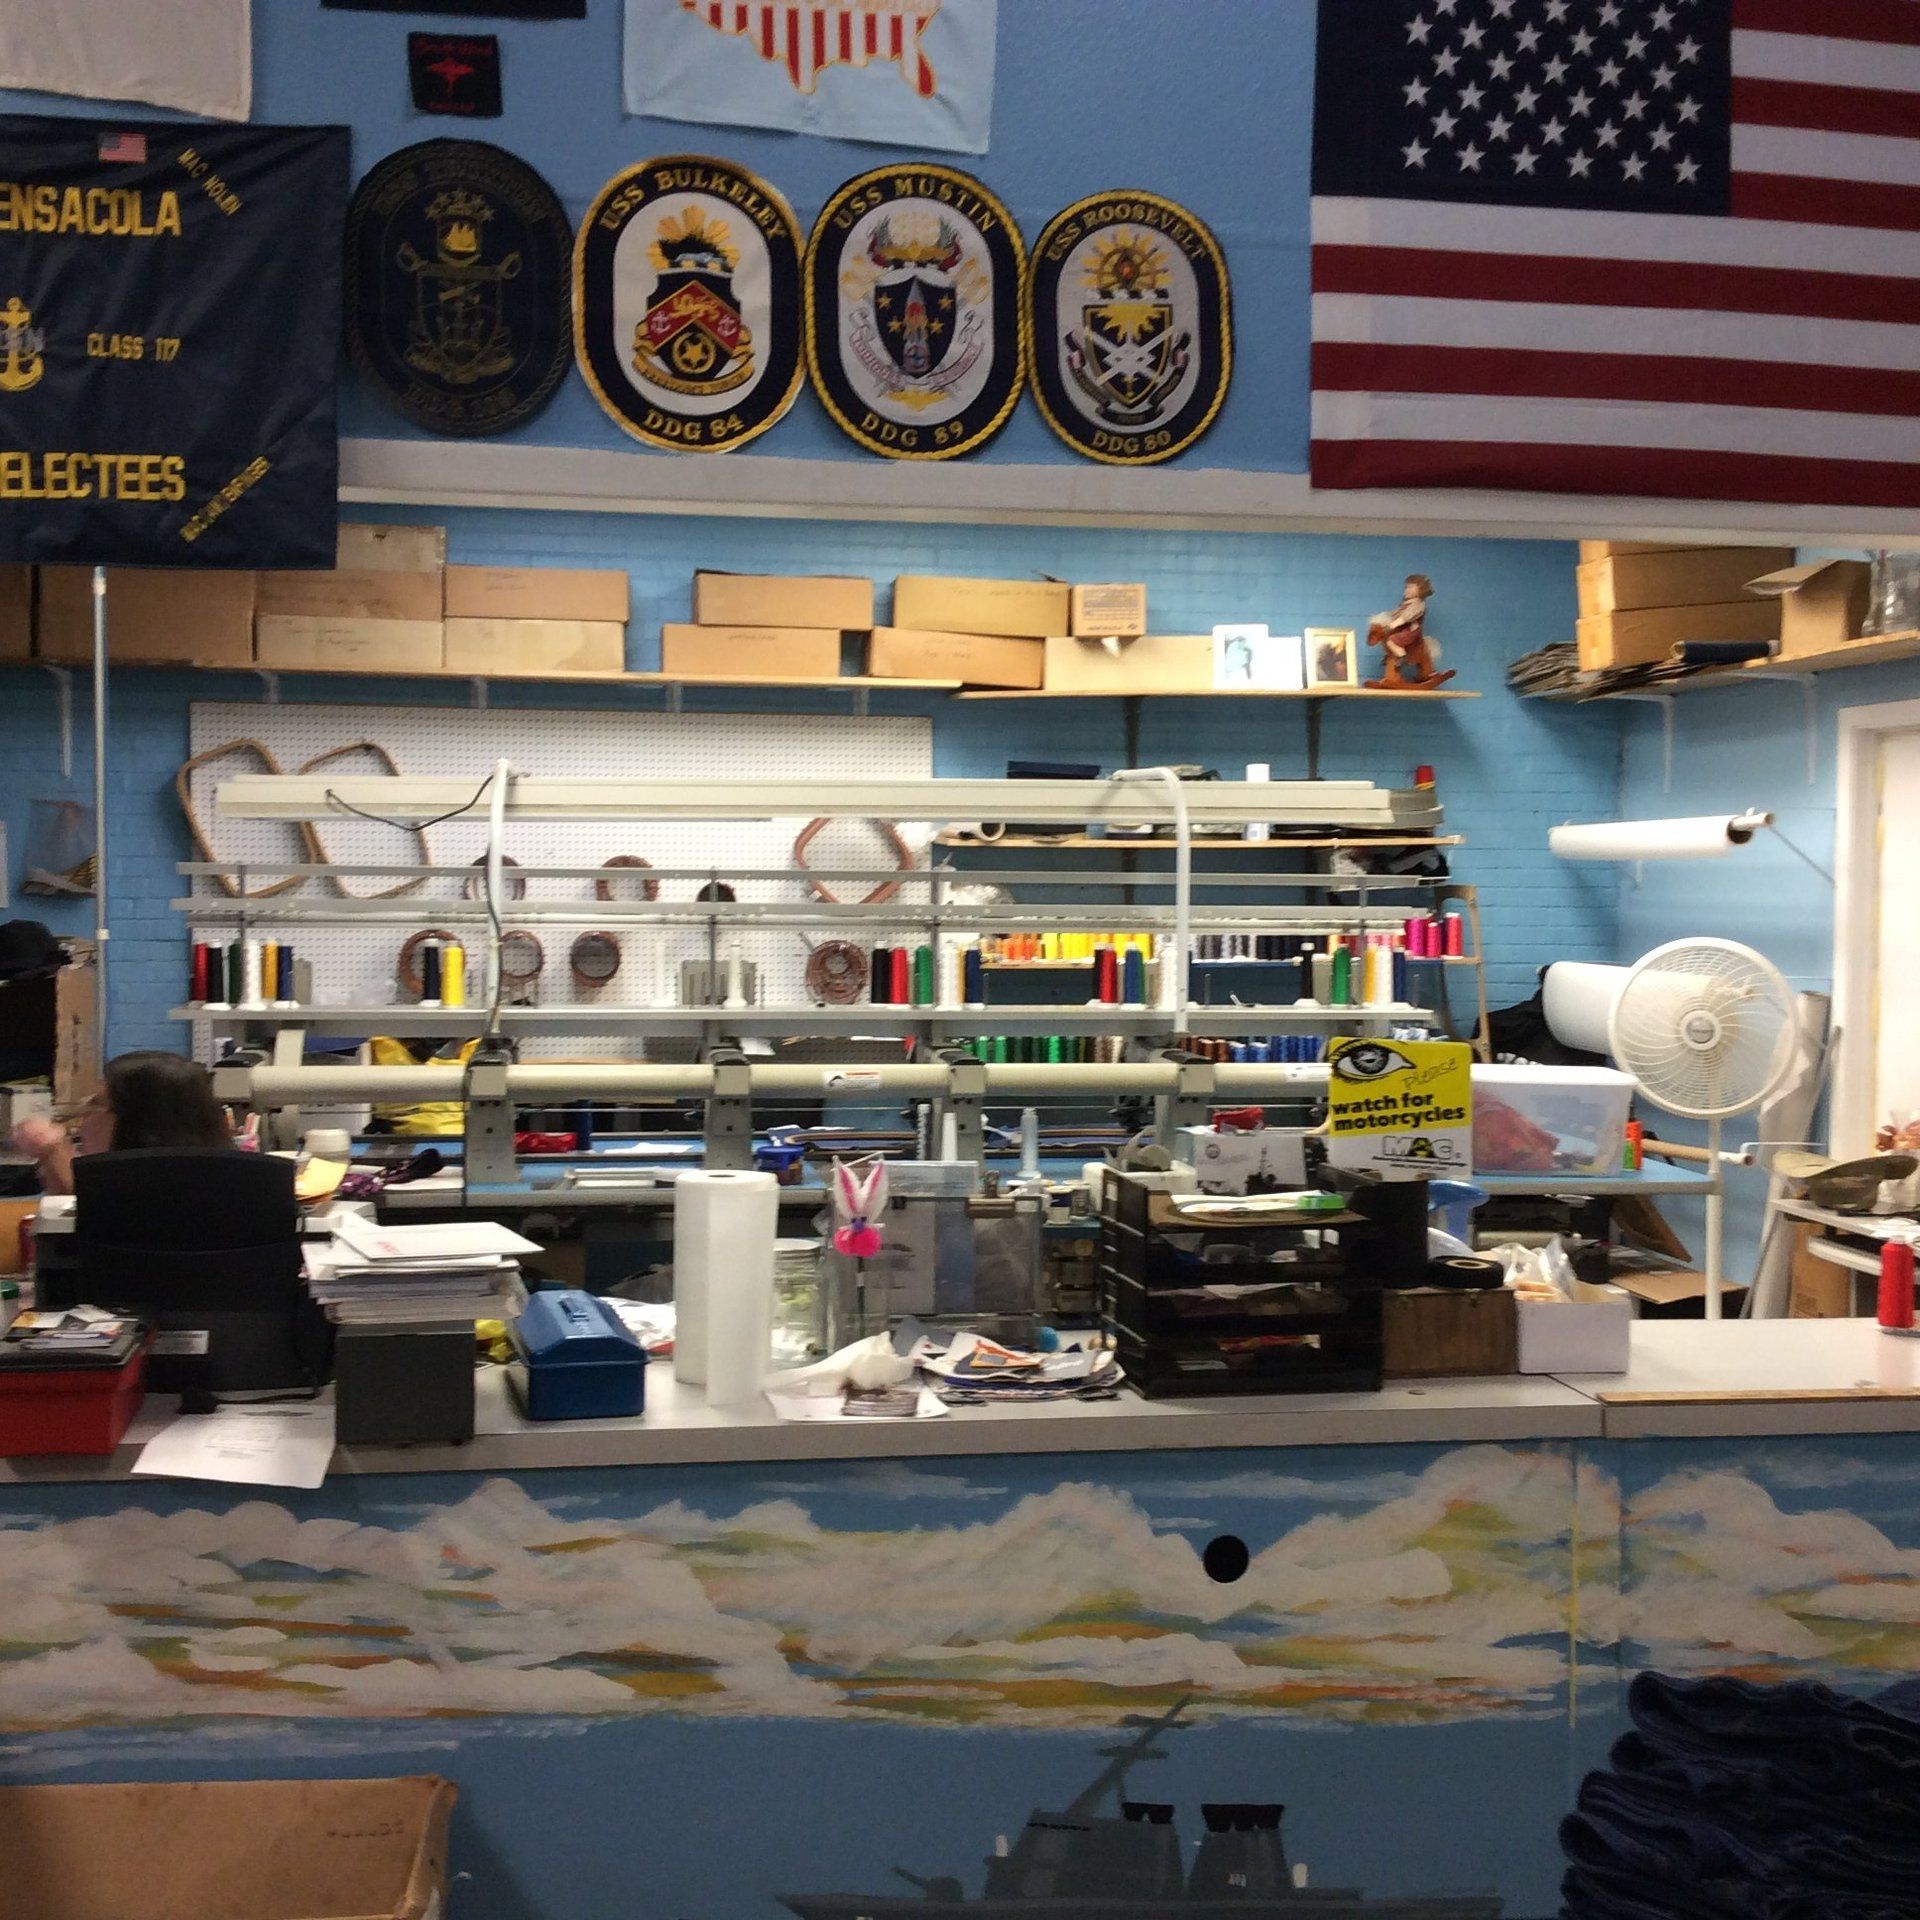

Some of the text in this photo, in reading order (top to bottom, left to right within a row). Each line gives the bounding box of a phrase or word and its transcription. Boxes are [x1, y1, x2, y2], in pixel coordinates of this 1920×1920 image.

[600, 184, 645, 230] USS
[654, 168, 787, 239] BULKELEY
[833, 177, 997, 234] USS MUSTIN
[1045, 203, 1207, 261] USS ROOSEVELT
[87, 333, 144, 360] CLASS
[643, 409, 744, 440] DDG 84
[861, 412, 964, 447] DDG 89
[1092, 430, 1171, 453] DDG 80
[0, 452, 187, 501] ELECTEES
[1332, 1092, 1434, 1115] watch for
[1334, 1106, 1466, 1131] motorcycles
